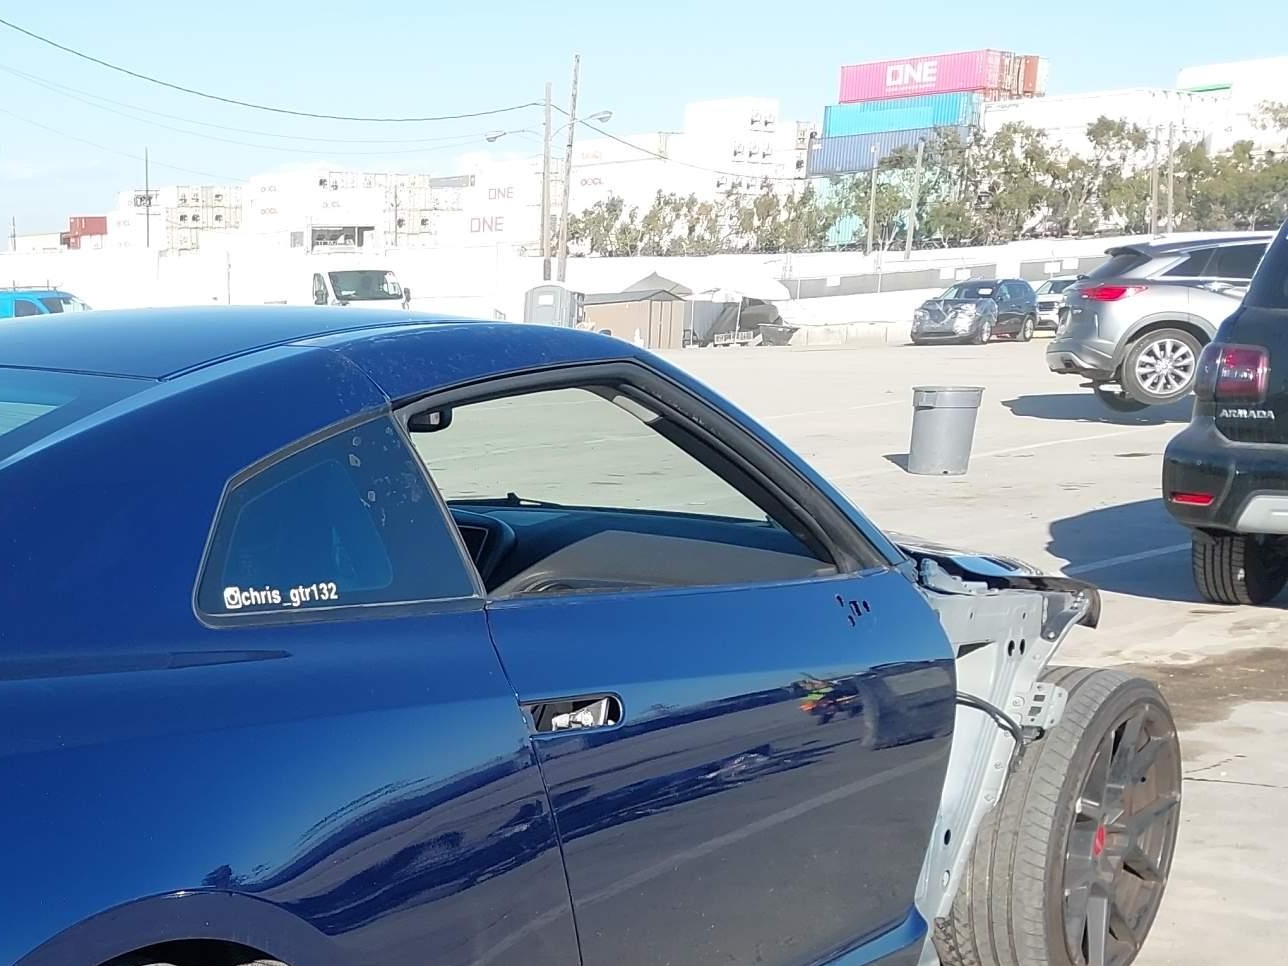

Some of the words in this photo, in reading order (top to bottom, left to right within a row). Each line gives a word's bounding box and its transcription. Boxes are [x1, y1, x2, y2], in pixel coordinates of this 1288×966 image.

[885, 61, 938, 87] ONE
[488, 187, 513, 200] ONE
[470, 216, 504, 233] ONE
[1219, 408, 1276, 420] ARMADA
[241, 582, 339, 608] chris_gtr132
